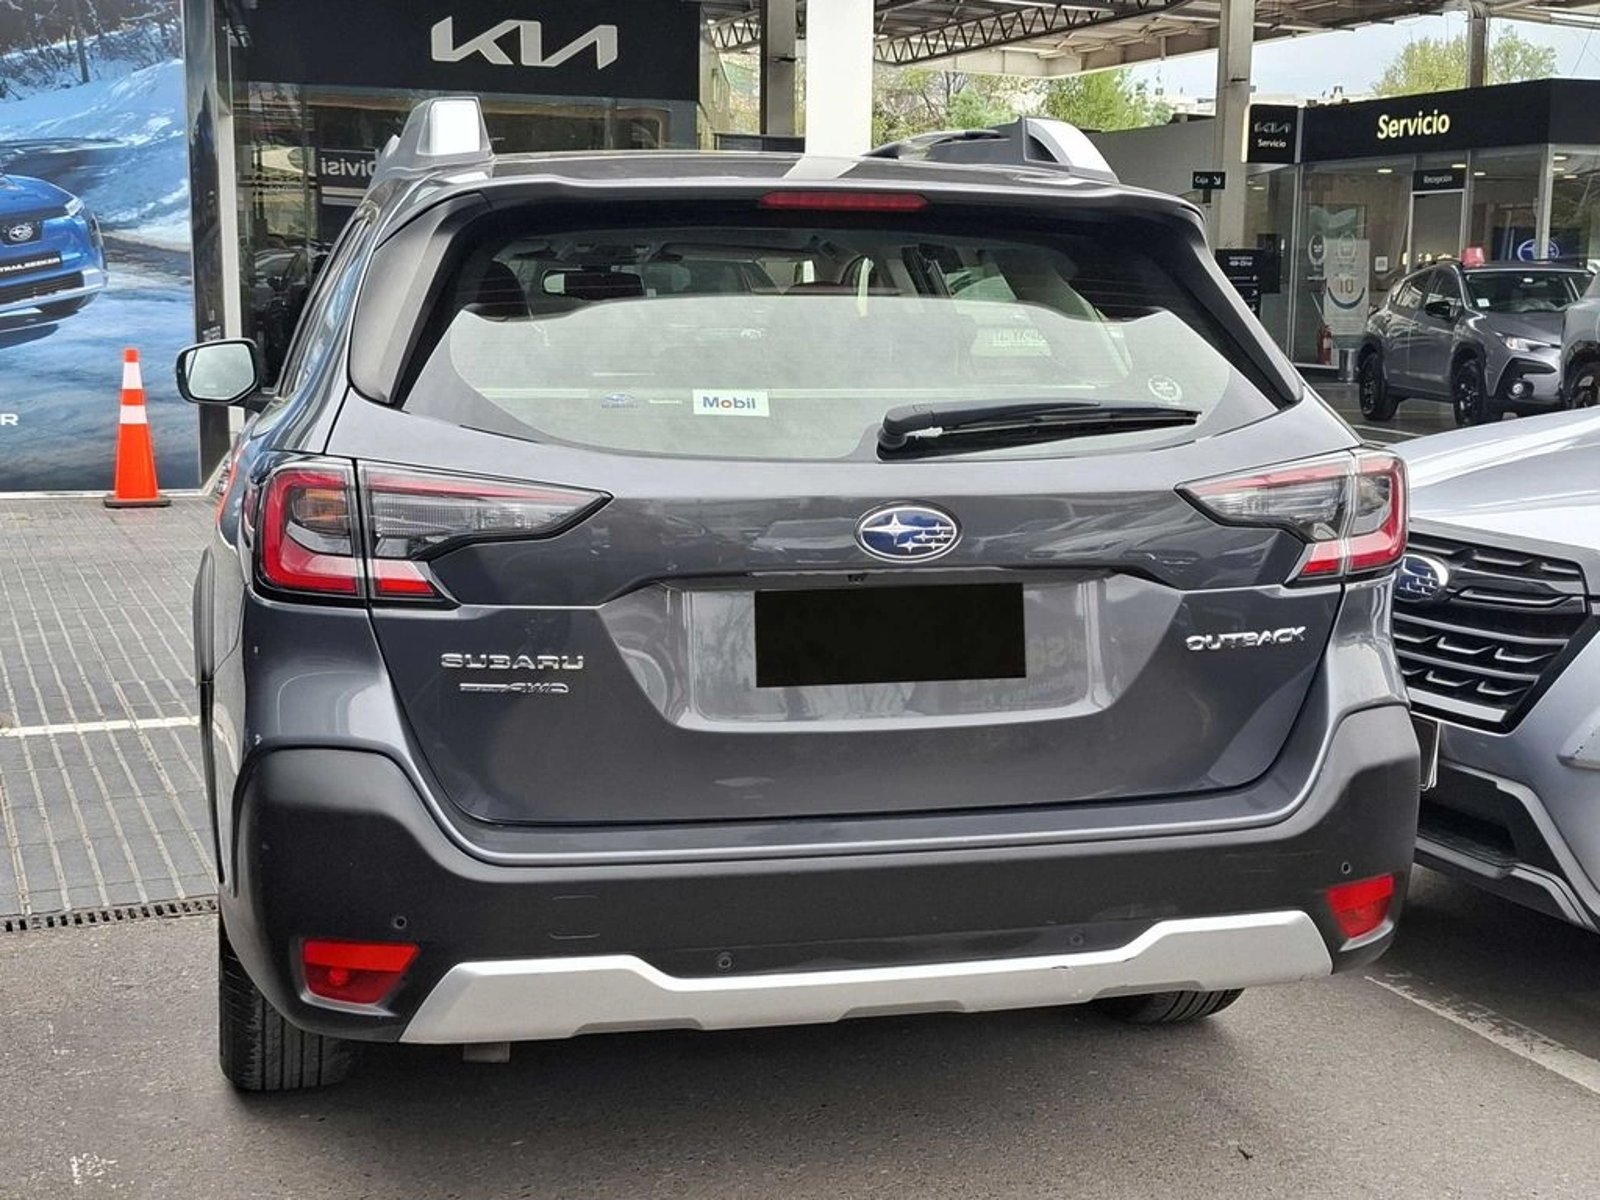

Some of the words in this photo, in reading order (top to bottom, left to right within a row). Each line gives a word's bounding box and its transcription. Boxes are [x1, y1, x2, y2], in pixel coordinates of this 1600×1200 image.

[431, 15, 618, 70] KIA
[1377, 109, 1450, 139] Servicio
[1257, 139, 1287, 148] Servicio
[702, 396, 756, 409] Mobil
[1185, 625, 1306, 651] OUTBACK
[440, 653, 584, 670] SUBARU
